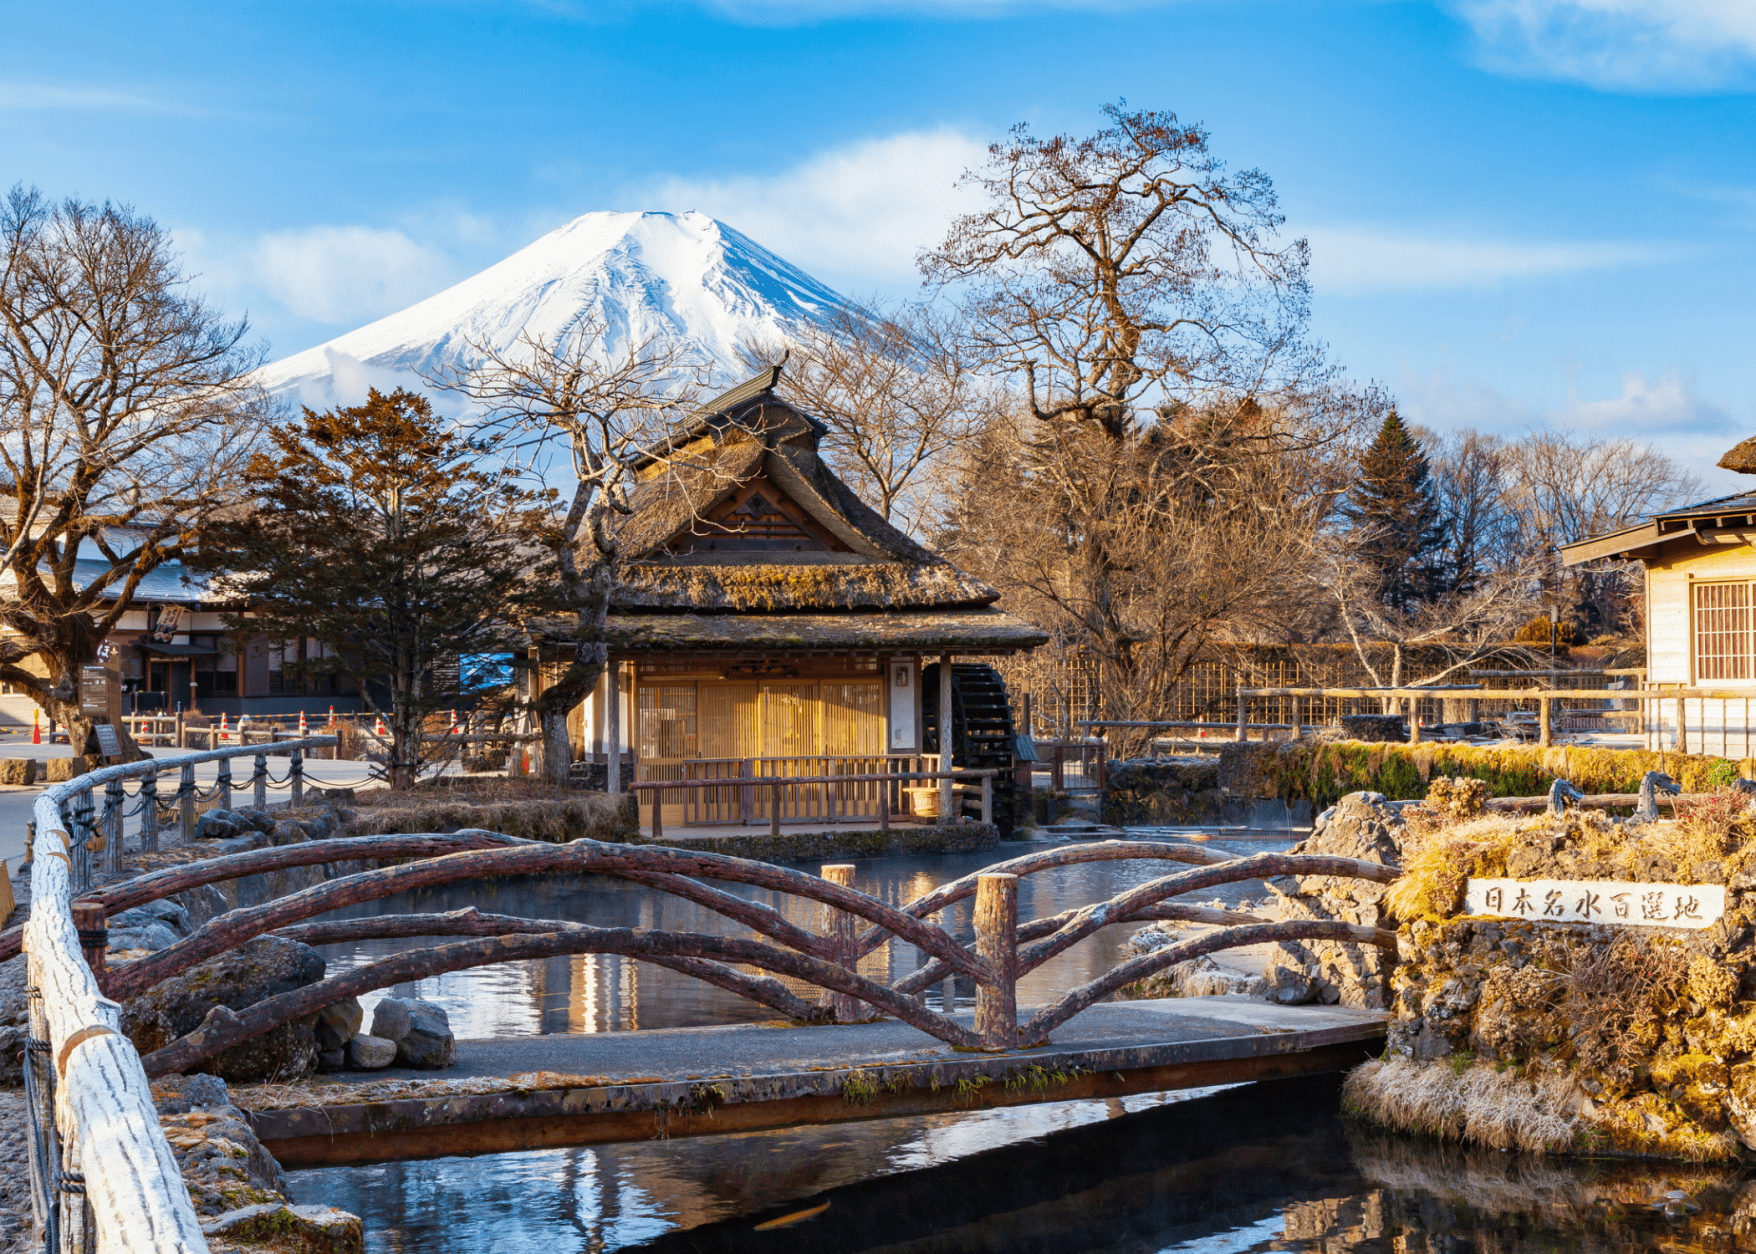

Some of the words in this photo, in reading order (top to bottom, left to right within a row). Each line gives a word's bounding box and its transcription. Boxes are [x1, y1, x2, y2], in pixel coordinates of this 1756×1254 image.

[97, 644, 111, 663] ほ
[1485, 887, 1703, 921] 日本名水百選地
